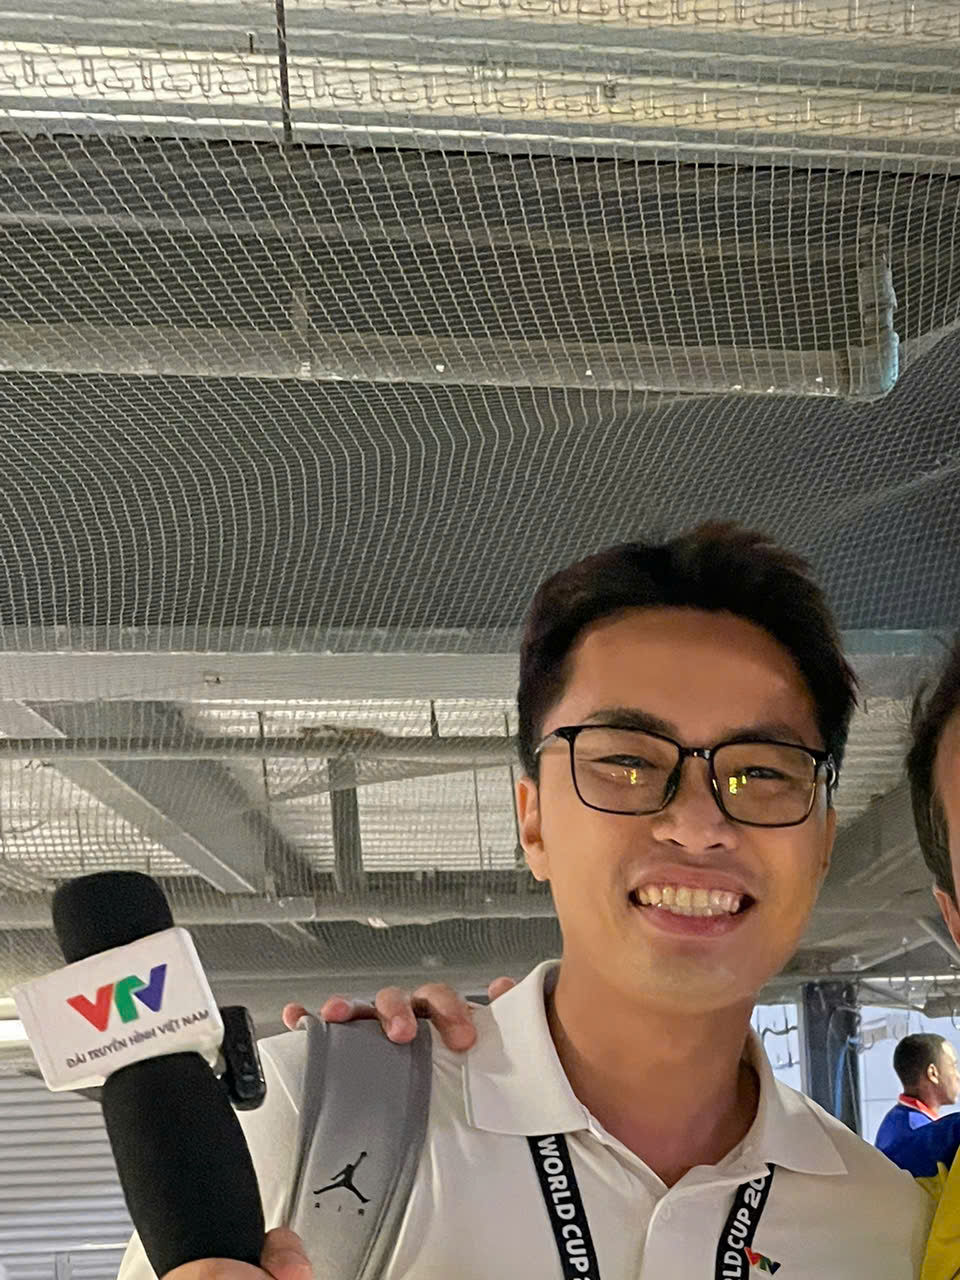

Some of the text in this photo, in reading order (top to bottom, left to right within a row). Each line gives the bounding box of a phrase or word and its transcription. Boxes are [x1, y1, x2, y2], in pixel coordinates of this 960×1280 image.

[66, 963, 167, 1033] VTV
[181, 1009, 209, 1026] NAM
[537, 1135, 577, 1220] WORLD
[561, 1224, 590, 1273] CUP
[727, 1207, 752, 1250] CUP
